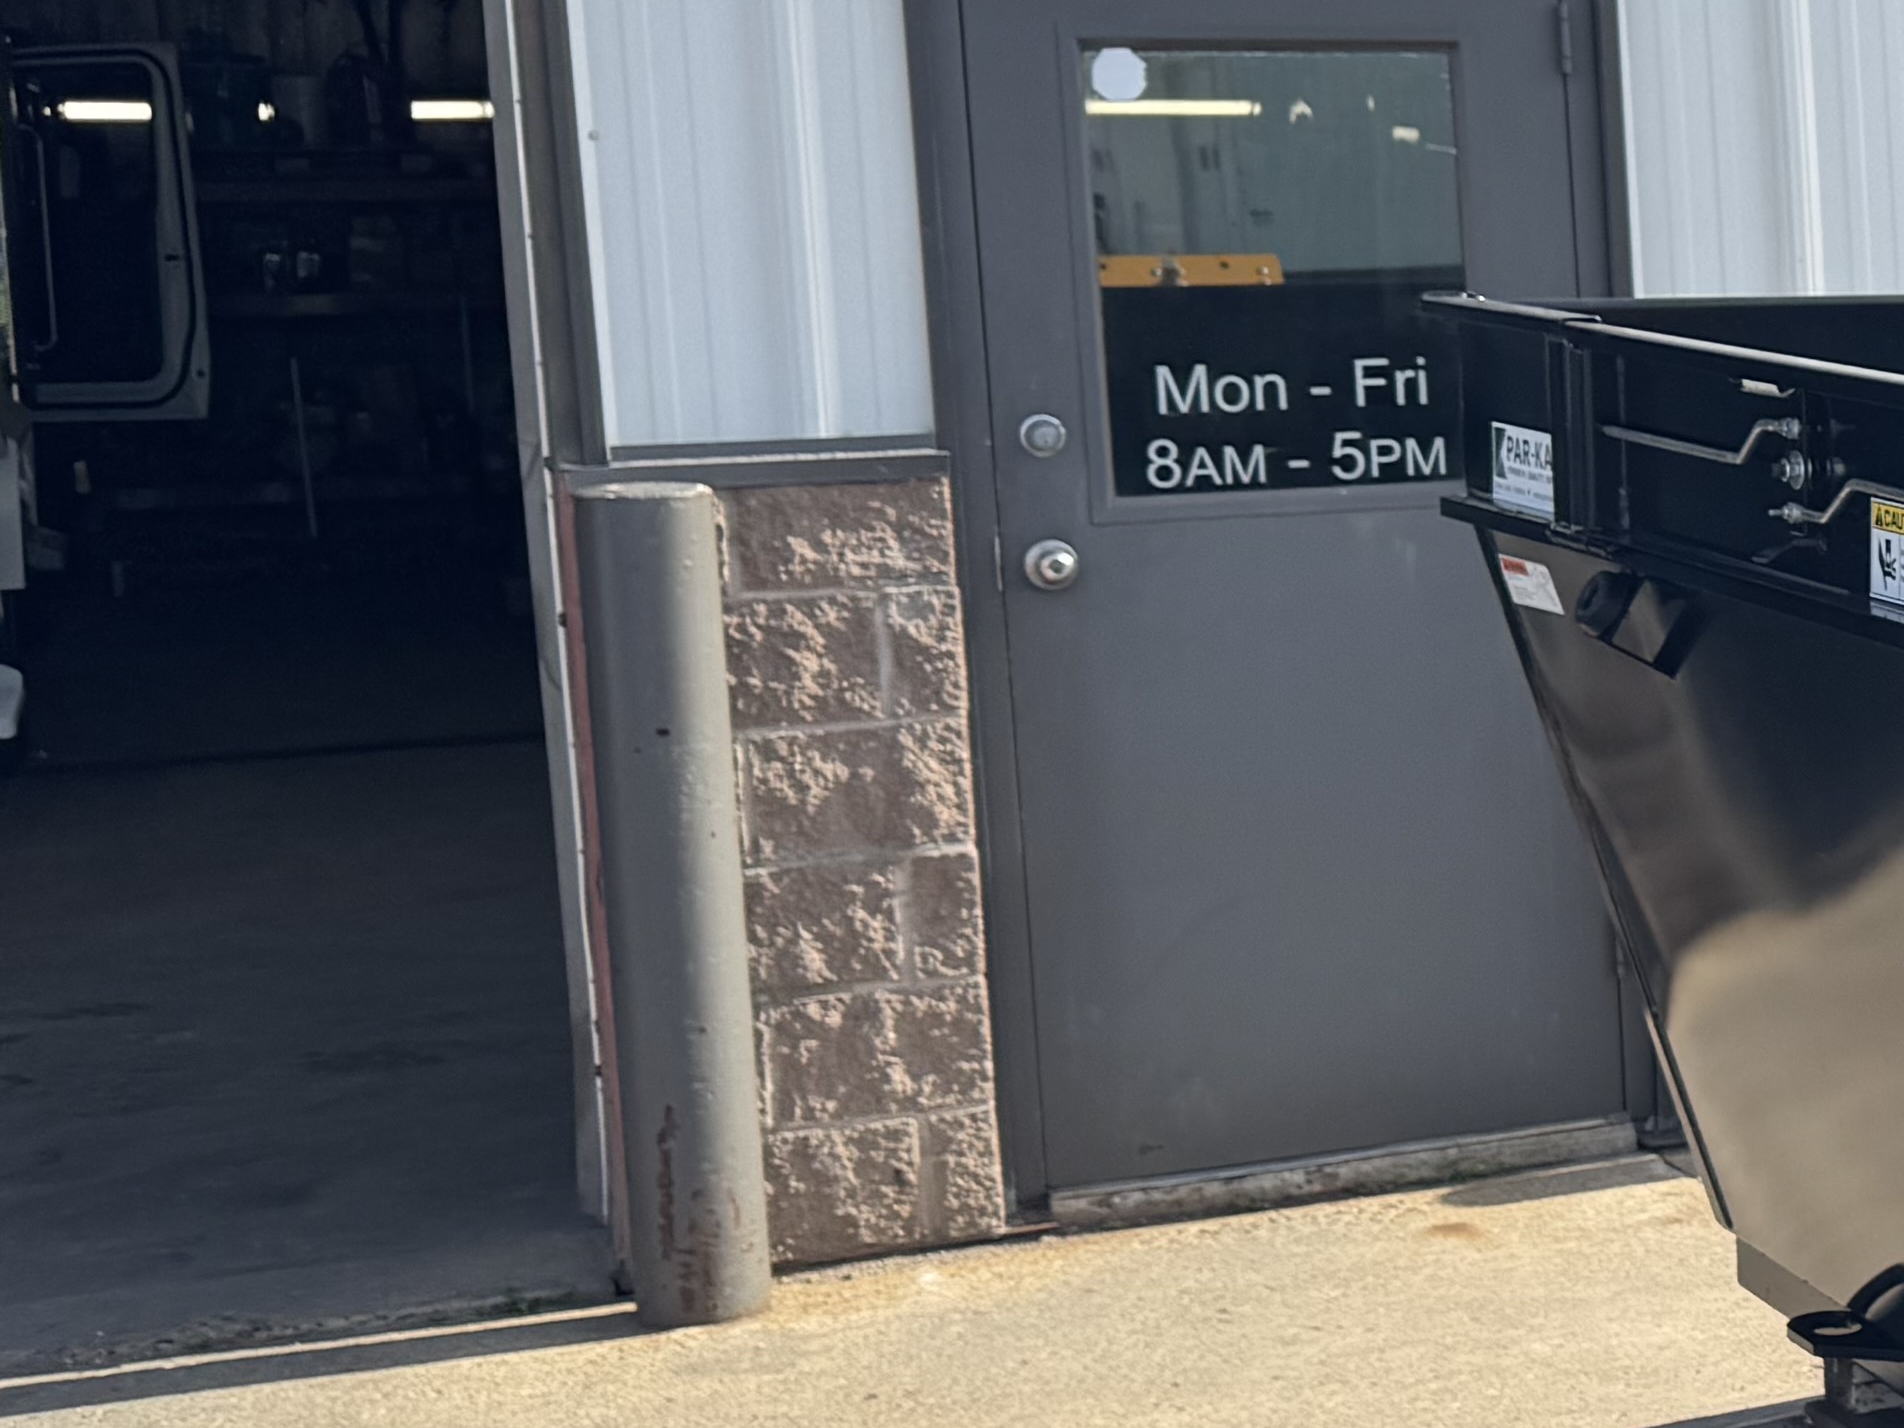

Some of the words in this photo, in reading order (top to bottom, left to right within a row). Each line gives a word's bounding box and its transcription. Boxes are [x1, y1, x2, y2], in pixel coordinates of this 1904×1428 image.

[1154, 363, 1288, 415] Mon
[1310, 385, 1332, 396] -
[1353, 356, 1429, 407] Fri
[1146, 438, 1268, 489] 8AM
[1287, 458, 1311, 469] -
[1331, 431, 1447, 481] 5PM
[1505, 435, 1552, 471] PAR-KA
